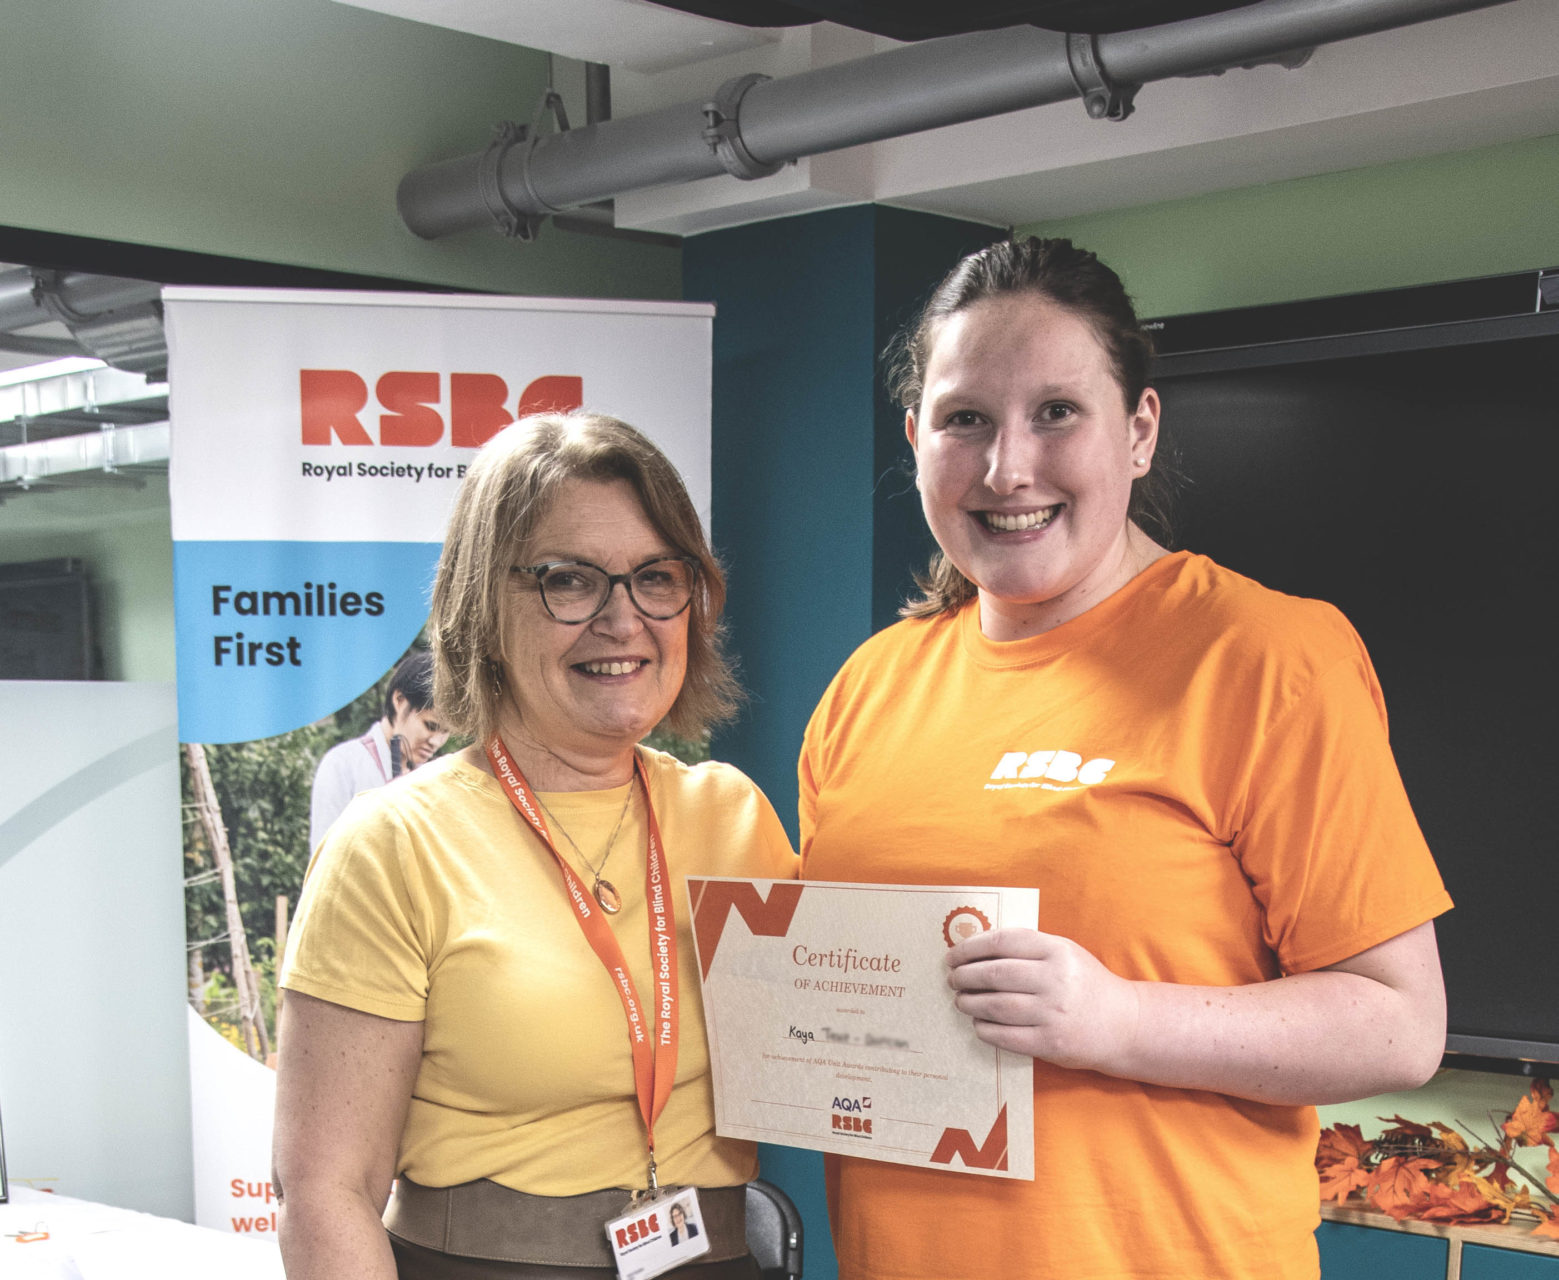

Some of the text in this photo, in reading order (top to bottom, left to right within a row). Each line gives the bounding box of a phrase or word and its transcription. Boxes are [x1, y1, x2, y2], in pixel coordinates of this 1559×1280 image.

[300, 369, 583, 448] RSBC
[301, 461, 353, 482] Royal
[357, 461, 425, 483] Society
[427, 462, 453, 479] for
[212, 581, 385, 617] Families
[214, 632, 302, 666] First
[491, 739, 501, 759] The
[497, 755, 521, 788] Royal
[514, 785, 542, 828] Society
[990, 750, 1116, 785] RSBC
[651, 884, 665, 914] Blind
[656, 914, 666, 933] for
[656, 932, 671, 979] Society
[792, 945, 901, 973] Certificate
[660, 981, 674, 1019] Royal
[794, 978, 906, 998] OF ACHIEVEMENT
[615, 967, 644, 1043] rsbc.org.uk
[660, 1023, 671, 1046] The
[789, 1025, 815, 1044] Kaya
[832, 1096, 862, 1112] AQA
[832, 1113, 872, 1134] RSBC
[615, 1213, 660, 1249] RSBC
